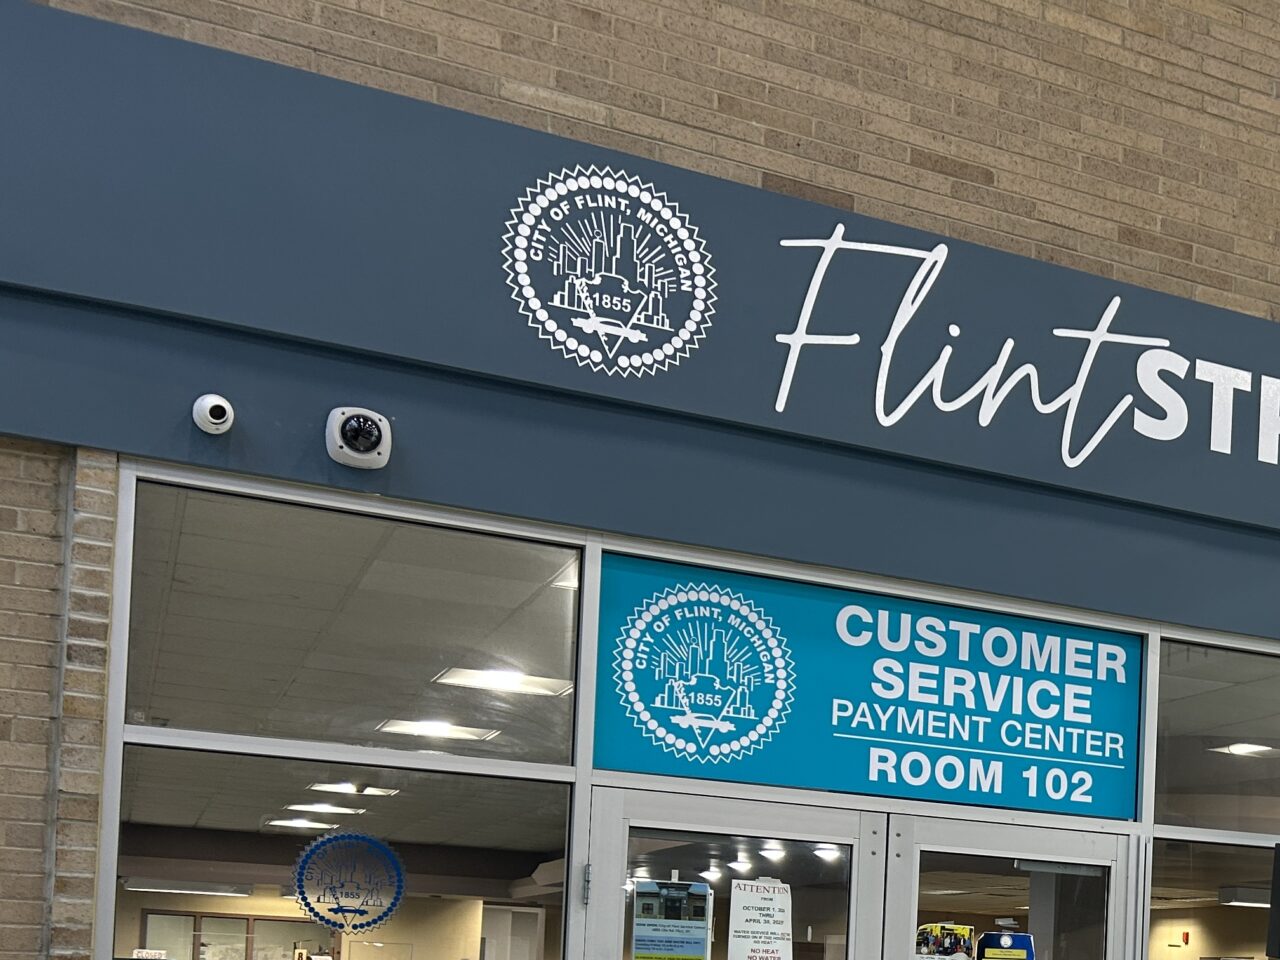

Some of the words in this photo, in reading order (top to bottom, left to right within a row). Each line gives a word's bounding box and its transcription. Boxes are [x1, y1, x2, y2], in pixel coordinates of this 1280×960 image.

[530, 218, 552, 261] CITY
[550, 201, 571, 221] OF
[575, 194, 632, 215] FLINT,
[637, 208, 693, 292] MICHIGAN
[592, 292, 632, 313] 1855
[635, 632, 656, 670] CITY
[653, 614, 672, 632] OF
[674, 606, 723, 622] FLINT,
[727, 614, 775, 684] MICHIGAN
[835, 604, 1127, 684] CUSTOMER
[688, 692, 722, 707] 1855
[871, 657, 1093, 724] SERVICE
[831, 698, 992, 743] PAYMENT
[1000, 720, 1125, 760] CENTER
[868, 746, 1003, 794] ROOM
[1022, 765, 1093, 803] 102
[340, 891, 360, 899] 1855
